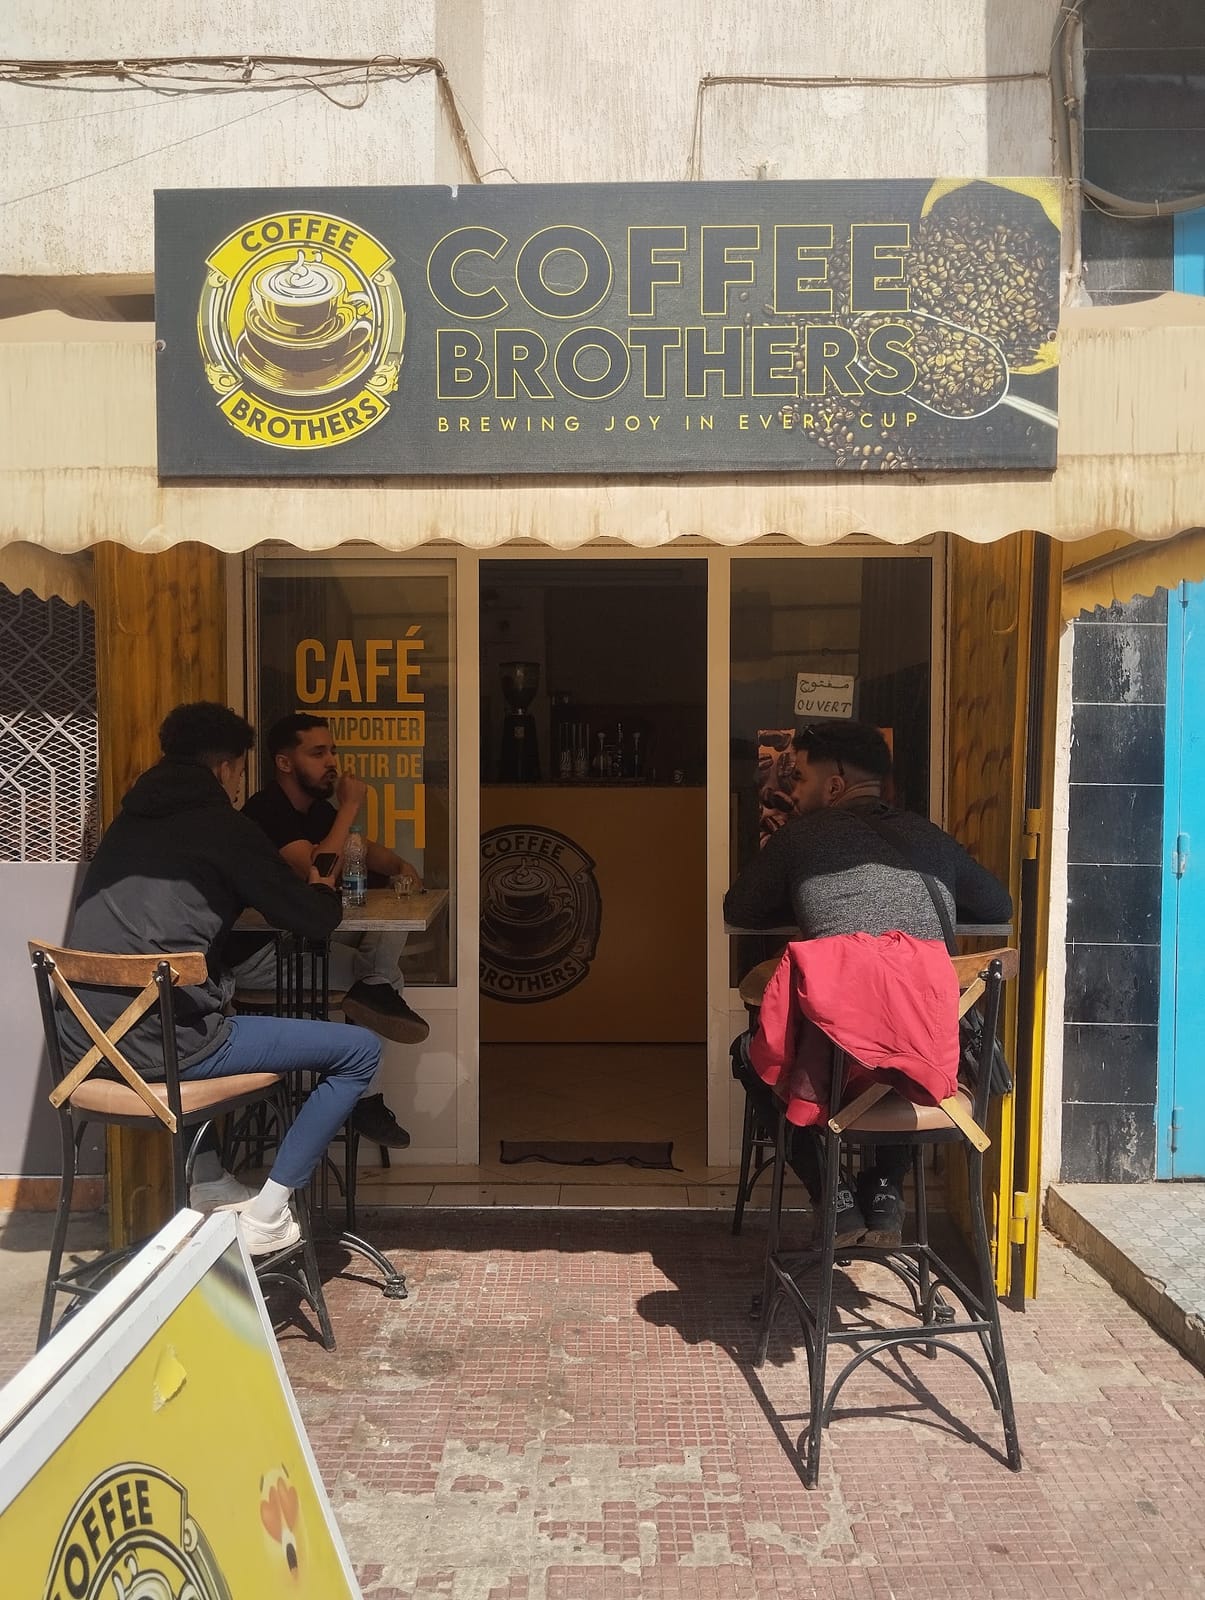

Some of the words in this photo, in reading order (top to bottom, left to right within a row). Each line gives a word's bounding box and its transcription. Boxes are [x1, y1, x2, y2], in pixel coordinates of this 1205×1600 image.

[240, 217, 359, 254] COFFEE
[426, 223, 911, 320] COFFEE
[436, 323, 919, 400] BROTHERS
[229, 396, 379, 442] BROTHERS
[438, 416, 580, 432] BREWING
[605, 415, 662, 431] JOY
[685, 414, 714, 430] IN
[740, 413, 834, 430] EVERY
[860, 412, 918, 428] CUP
[295, 624, 425, 704] CAFÉ
[797, 699, 852, 713] OUVERT
[329, 717, 421, 741] MPORTER
[335, 753, 390, 778] ARTIR
[396, 753, 422, 778] DE
[481, 835, 565, 861] COFFEE
[54, 1479, 153, 1600] OFFEE
